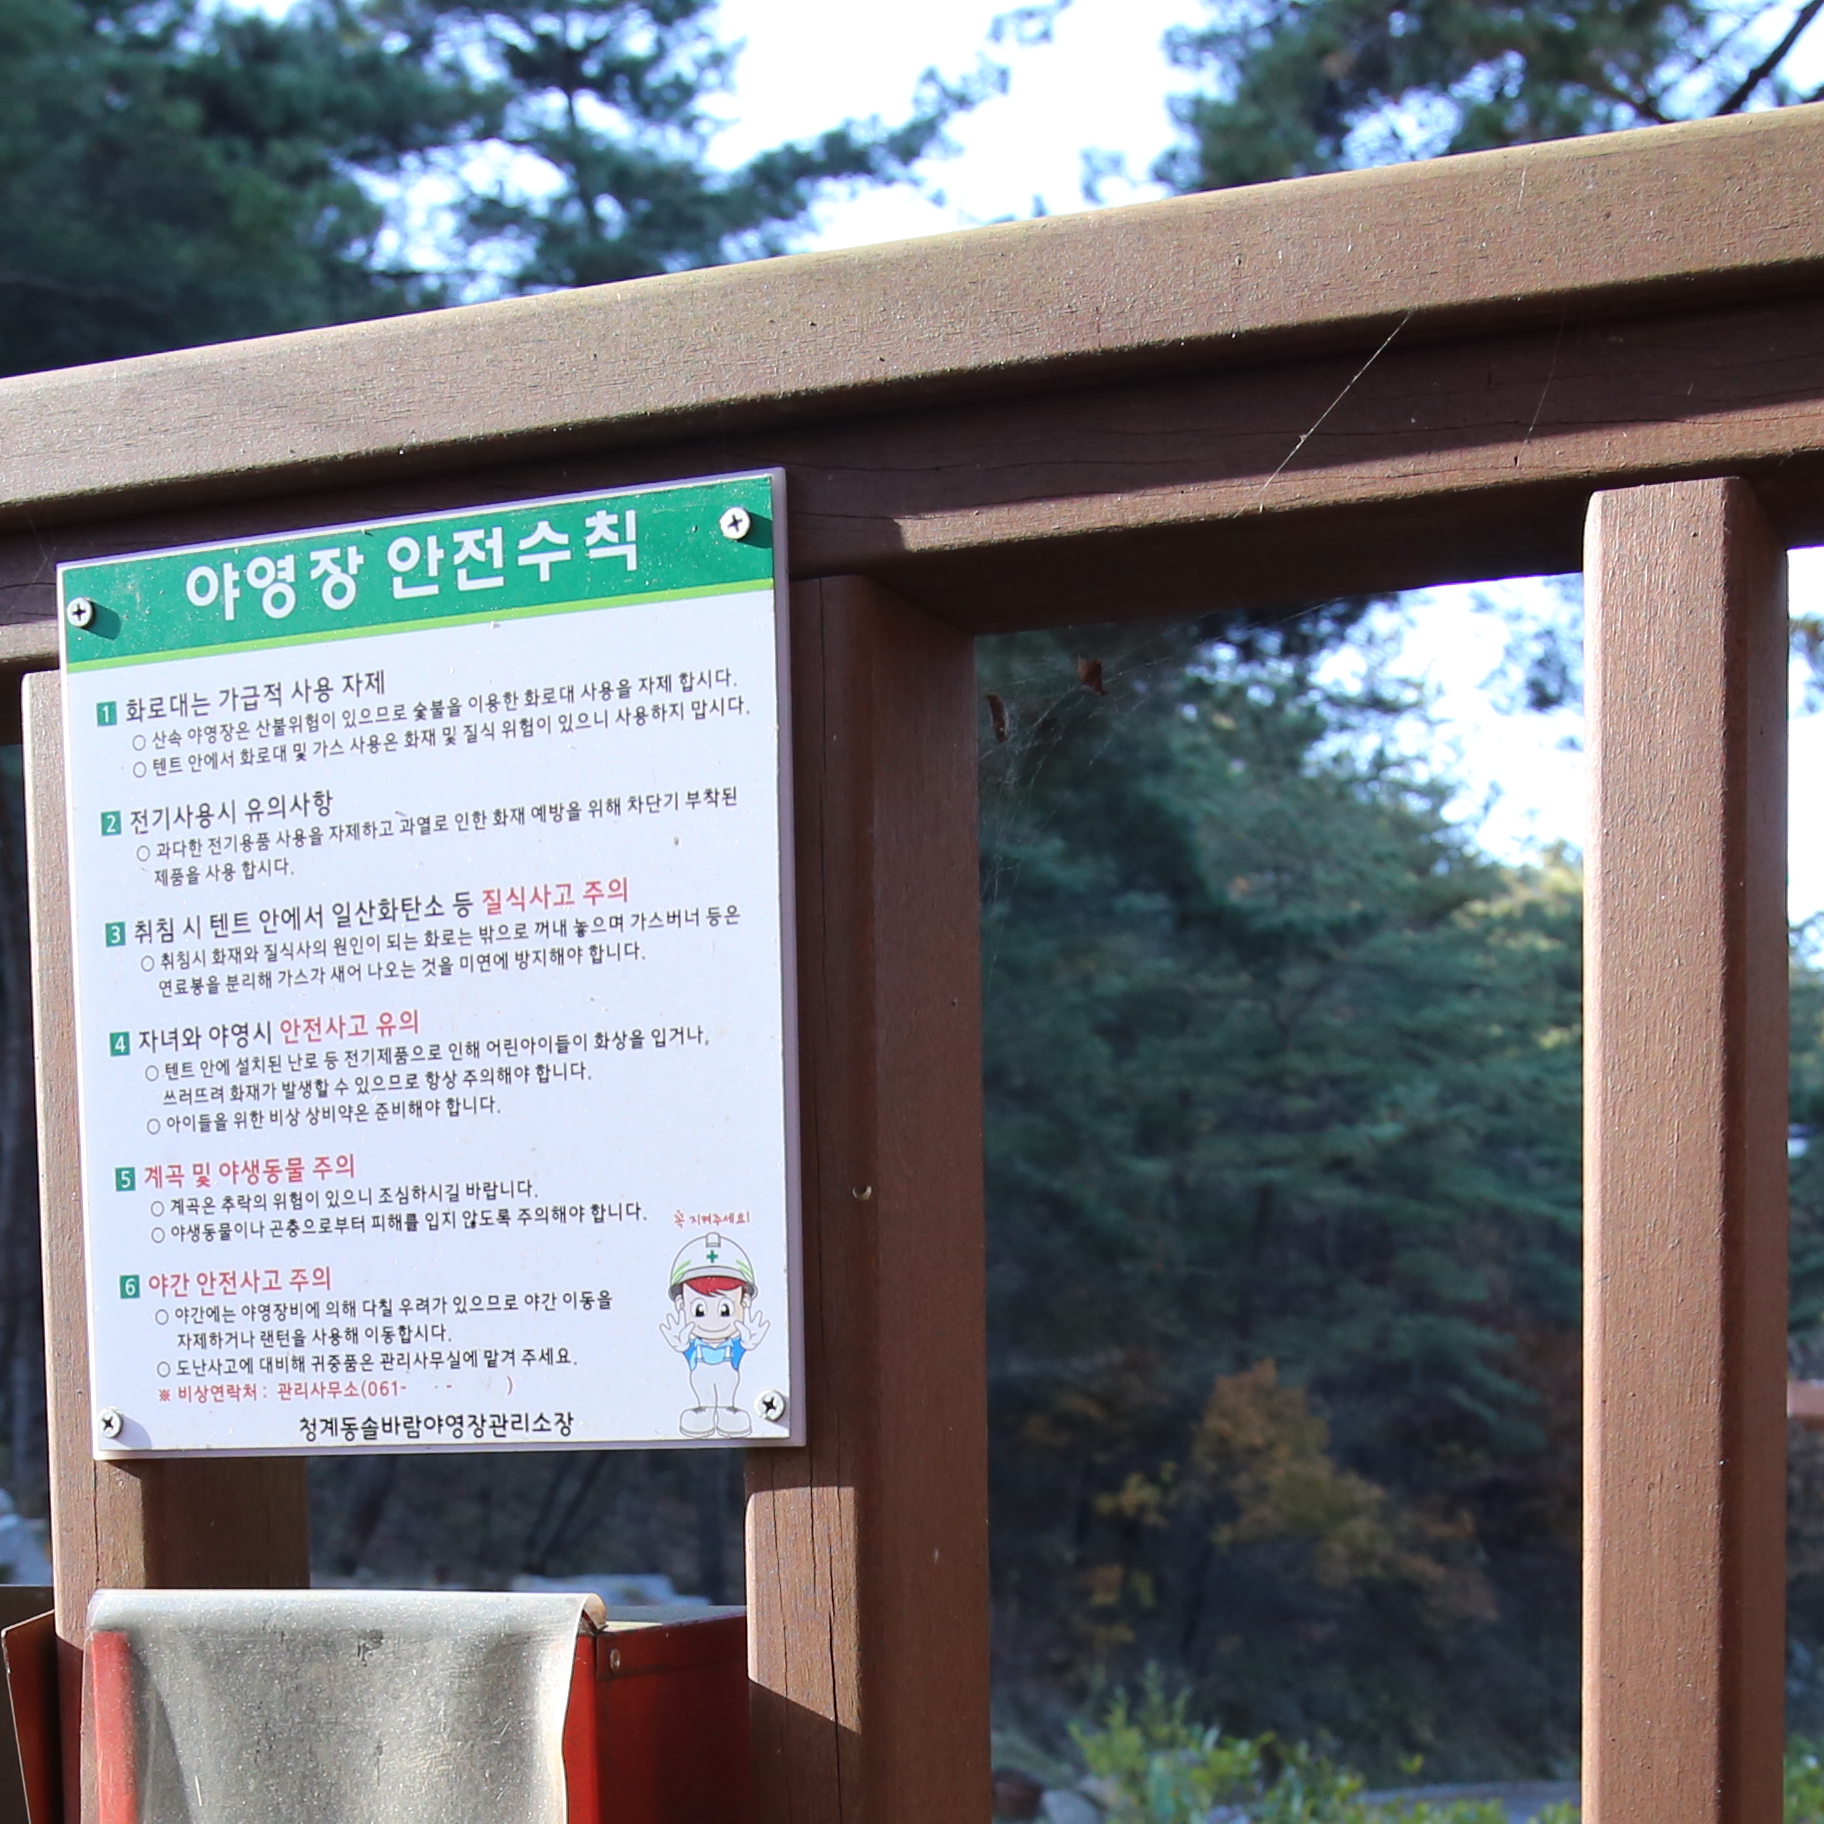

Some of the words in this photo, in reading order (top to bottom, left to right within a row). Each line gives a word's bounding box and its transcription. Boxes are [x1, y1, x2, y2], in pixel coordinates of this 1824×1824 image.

[184, 544, 365, 621] 야영장
[386, 508, 638, 601] 안전수칙
[125, 692, 211, 723] 화로대는
[218, 681, 282, 713] 가급적
[290, 676, 335, 704] 사용
[341, 669, 385, 698] 자제
[152, 729, 183, 750] 산속
[187, 720, 251, 745] 야영장은
[255, 711, 336, 739] 산불위험이
[341, 703, 408, 729] 있으므로
[412, 696, 463, 722] 숯불을
[468, 690, 519, 714] 이용한
[523, 684, 575, 708] 화로대
[580, 678, 632, 702] 사용을
[638, 673, 673, 696] 자제
[678, 667, 737, 694] 합시다.
[152, 756, 183, 777] 텐트
[187, 749, 235, 773] 안에서
[239, 744, 287, 767] 화로대
[292, 742, 307, 763] 및
[313, 739, 345, 759] 가스
[350, 732, 399, 755] 사용은
[404, 728, 436, 749] 화재
[442, 725, 457, 747] 및
[463, 721, 495, 745] 질식
[501, 715, 552, 739] 위험이
[557, 709, 609, 734] 있으니
[615, 701, 685, 727] 사용하지
[130, 799, 236, 835] 전기사용시
[244, 789, 334, 824] 유의사항
[156, 838, 203, 860] 과다한
[207, 831, 271, 856] 전기용품
[275, 826, 324, 849] 사용을
[328, 820, 395, 843] 자제하고
[399, 814, 449, 836] 과열로
[454, 809, 488, 832] 인한
[492, 806, 525, 827] 화재
[530, 800, 582, 824] 예방을
[588, 797, 622, 819] 위해
[627, 791, 679, 815] 차단기
[685, 785, 738, 810] 부착된
[154, 865, 201, 888] 제품을
[205, 862, 237, 883] 사용
[241, 857, 294, 881] 합시다.
[134, 917, 175, 945] 취침
[182, 914, 201, 940] 시
[209, 911, 252, 939] 텐트
[258, 903, 324, 935] 안에서
[331, 894, 445, 929] 일산화탄소
[452, 891, 474, 919] 등
[482, 883, 575, 916] 질식사고
[582, 876, 628, 907] 주의
[160, 949, 206, 971] 취침시
[211, 944, 260, 966] 화재와
[263, 938, 327, 963] 질식사의
[333, 934, 381, 957] 원인이
[386, 932, 419, 952] 되는
[424, 927, 474, 948] 화로는
[478, 922, 529, 945] 밖으로
[534, 918, 568, 939] 꺼내
[630, 907, 700, 932] 가스버너
[705, 904, 741, 928] 등은
[158, 974, 221, 999] 연료봉을
[225, 970, 272, 994] 분리해
[278, 966, 326, 988] 가스가
[330, 963, 362, 984] 새어
[367, 960, 416, 981] 나오는
[421, 955, 454, 978] 것을
[459, 951, 509, 973] 미연에
[514, 945, 584, 971] 방지해야
[588, 940, 646, 966] 합니다.
[138, 1025, 203, 1054] 자녀와
[208, 1020, 272, 1049] 야영시
[279, 1014, 369, 1045] 안전사고
[375, 1009, 419, 1038] 유의
[164, 1061, 196, 1081] 텐트
[199, 1058, 231, 1079] 안에
[235, 1054, 282, 1077] 설치된
[287, 1052, 319, 1073] 난로
[323, 1050, 339, 1071] 등
[344, 1043, 443, 1069] 전기제품으로
[448, 1040, 481, 1062] 인해
[486, 1032, 588, 1058] 어린아이들이
[593, 1028, 646, 1051] 화상을
[651, 1025, 709, 1049] 입거나,
[162, 1085, 225, 1106] 쓰러뜨려
[229, 1082, 277, 1103] 화재가
[281, 1078, 330, 1101] 발생할
[334, 1077, 350, 1097] 수
[354, 1073, 420, 1096] 있으므로
[425, 1069, 458, 1092] 항상
[462, 1064, 531, 1088] 주의해야
[534, 1061, 592, 1085] 합니다.
[166, 1112, 229, 1134] 아이들을
[233, 1109, 265, 1130] 위한
[269, 1107, 301, 1128] 비상
[305, 1103, 370, 1127] 상비약은
[374, 1098, 441, 1122] 준비해야
[445, 1094, 501, 1118] 합니다.
[144, 1164, 185, 1189] 계곡
[192, 1161, 211, 1189] 및
[218, 1157, 306, 1186] 야생동물
[312, 1153, 355, 1181] 주의
[170, 1196, 217, 1216] 계곡은
[221, 1193, 267, 1214] 추락의
[273, 1190, 320, 1211] 위험이
[324, 1187, 373, 1209] 있으니
[378, 1182, 460, 1206] 조심하시길
[465, 1179, 539, 1202] 바랍니다.
[170, 1220, 266, 1243] 야생동물이나
[269, 1215, 366, 1239] 곤충으로부터
[371, 1212, 420, 1233] 피해를
[424, 1210, 456, 1232] 입지
[461, 1208, 512, 1230] 않도록
[516, 1204, 586, 1227] 주의해야
[590, 1201, 647, 1224] 합니다.
[148, 1272, 190, 1298] 야간
[196, 1269, 283, 1297] 안전사고
[289, 1266, 331, 1293] 주의
[174, 1305, 237, 1325] 야간에는
[241, 1301, 321, 1323] 야영장비에
[325, 1299, 357, 1319] 의해
[362, 1298, 393, 1318] 다칠
[398, 1296, 448, 1317] 우려가
[452, 1294, 519, 1315] 있으므로
[524, 1292, 558, 1312] 야간
[562, 1289, 613, 1311] 이동을
[177, 1330, 256, 1351] 자제하거나
[260, 1328, 307, 1349] 랜턴을
[311, 1326, 359, 1347] 사용해
[364, 1323, 452, 1346] 이동합시다.
[176, 1357, 254, 1378] 도난사고에
[259, 1354, 306, 1375] 대비해
[310, 1352, 375, 1374] 귀중품은
[379, 1349, 478, 1372] 관리사무실에
[483, 1348, 516, 1369] 맡겨
[521, 1347, 578, 1367] 주세요.
